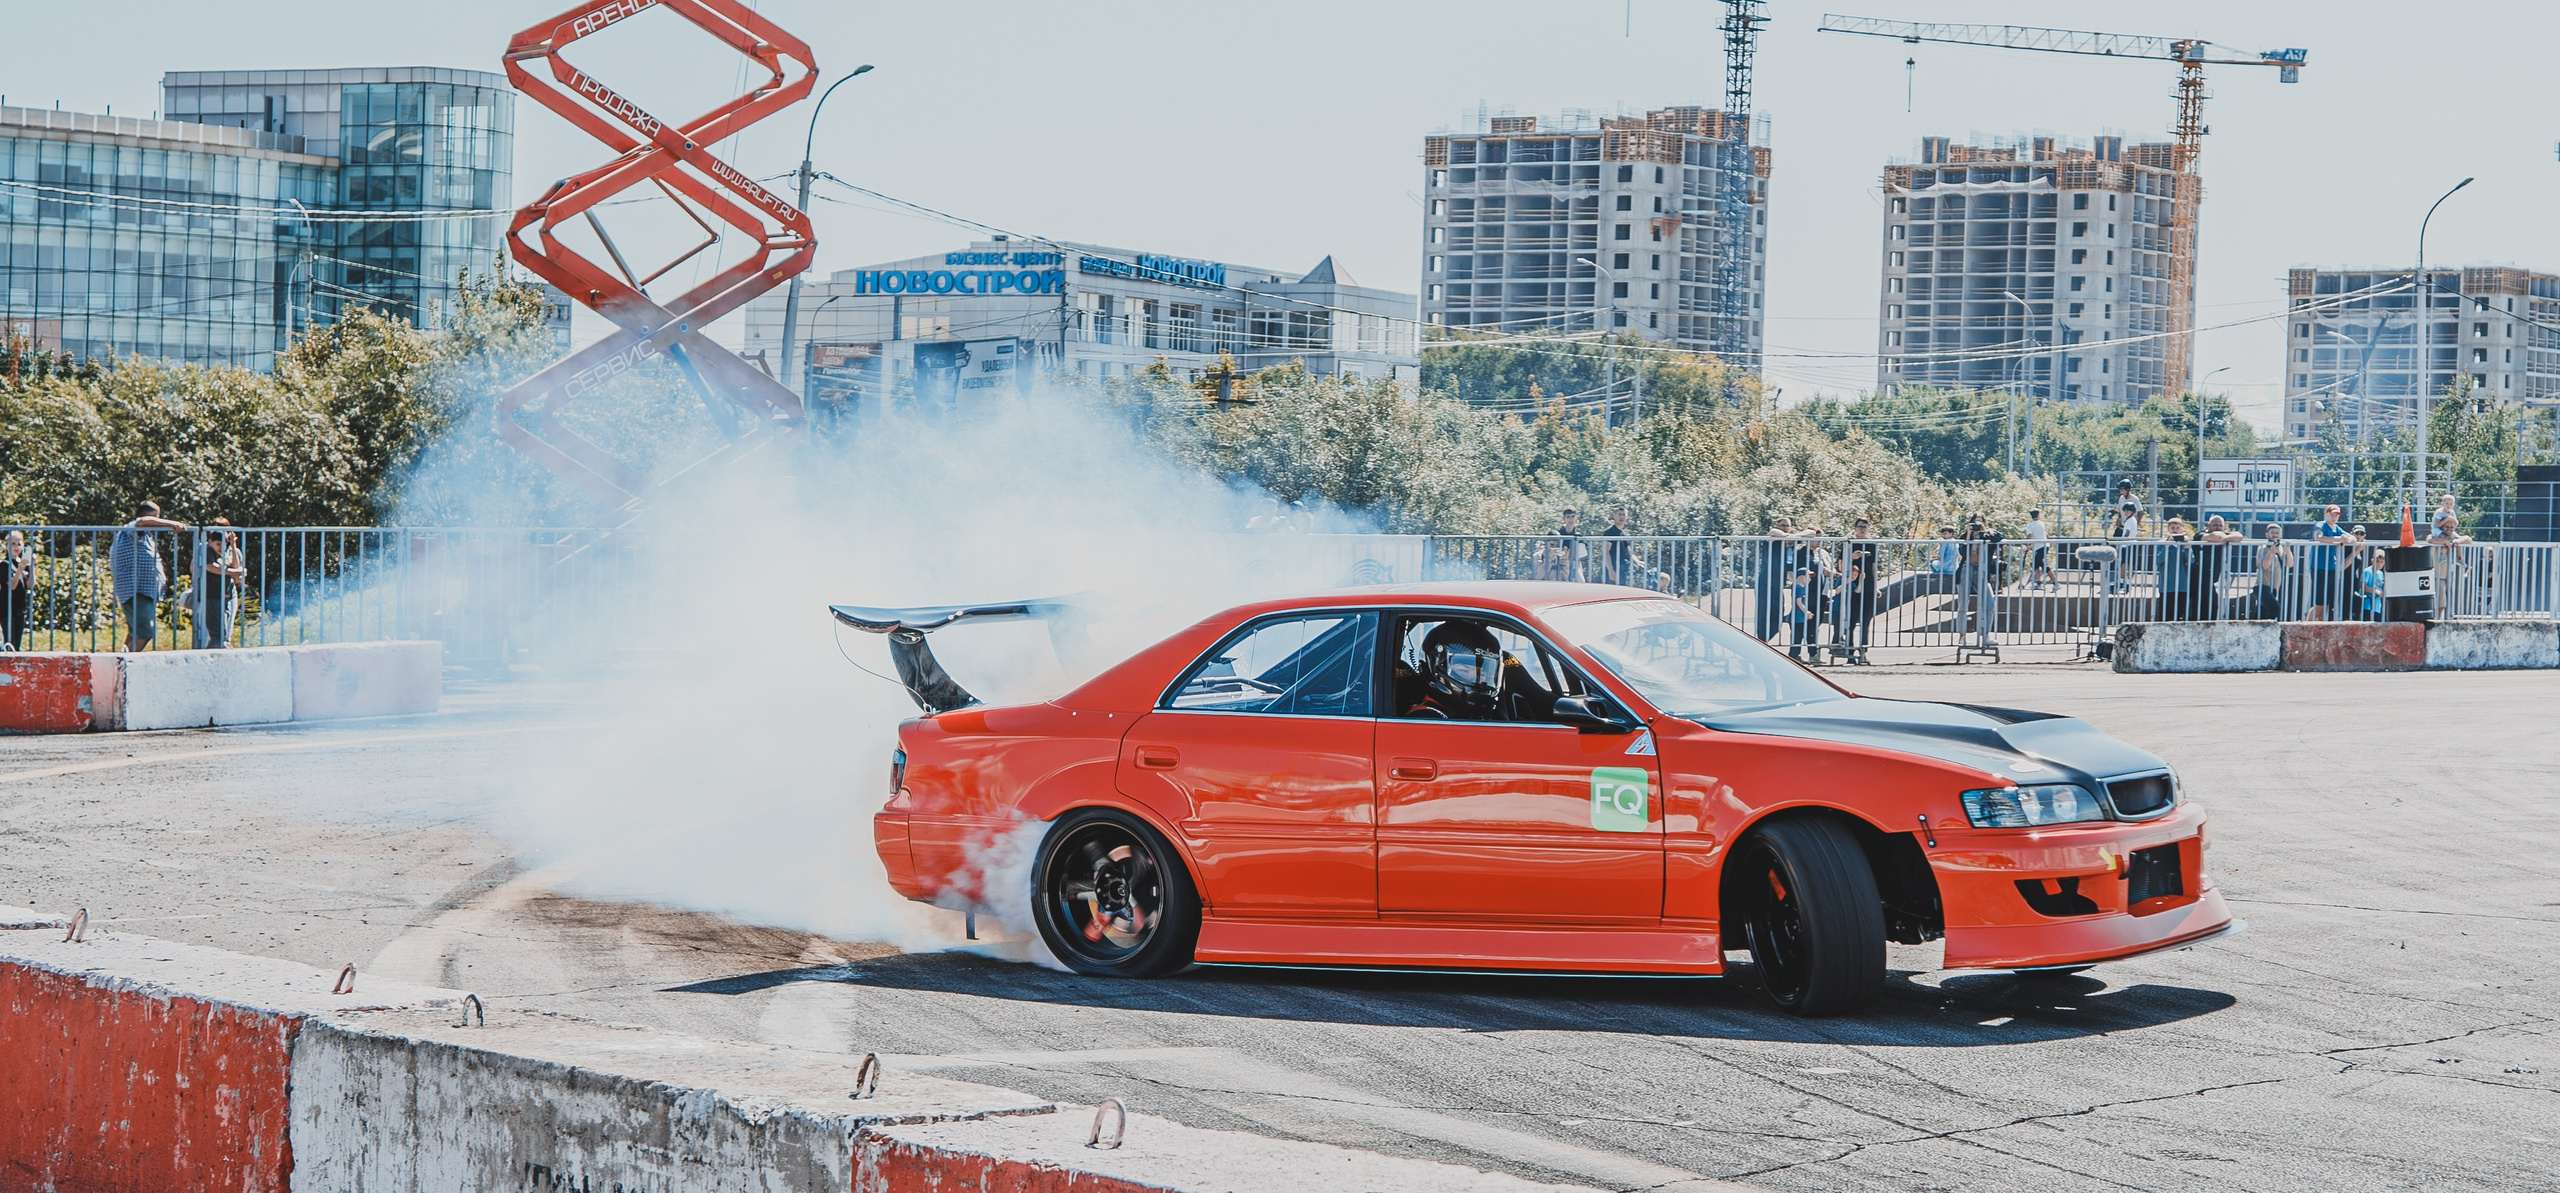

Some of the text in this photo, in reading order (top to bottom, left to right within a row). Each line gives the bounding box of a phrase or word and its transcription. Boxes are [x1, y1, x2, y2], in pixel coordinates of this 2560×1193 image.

[569, 69, 662, 137] ПРОДАЖА
[711, 159, 798, 222] WWW.ARLIFT.RU
[945, 251, 1063, 268] БИЗНЕС-ЦЕНТР
[1138, 253, 1226, 287] НОВОСТРОЙ
[856, 266, 1065, 294] НОВОСТРОЙ
[564, 338, 656, 400] СЕРВИС
[1594, 783, 1644, 815] FQ
